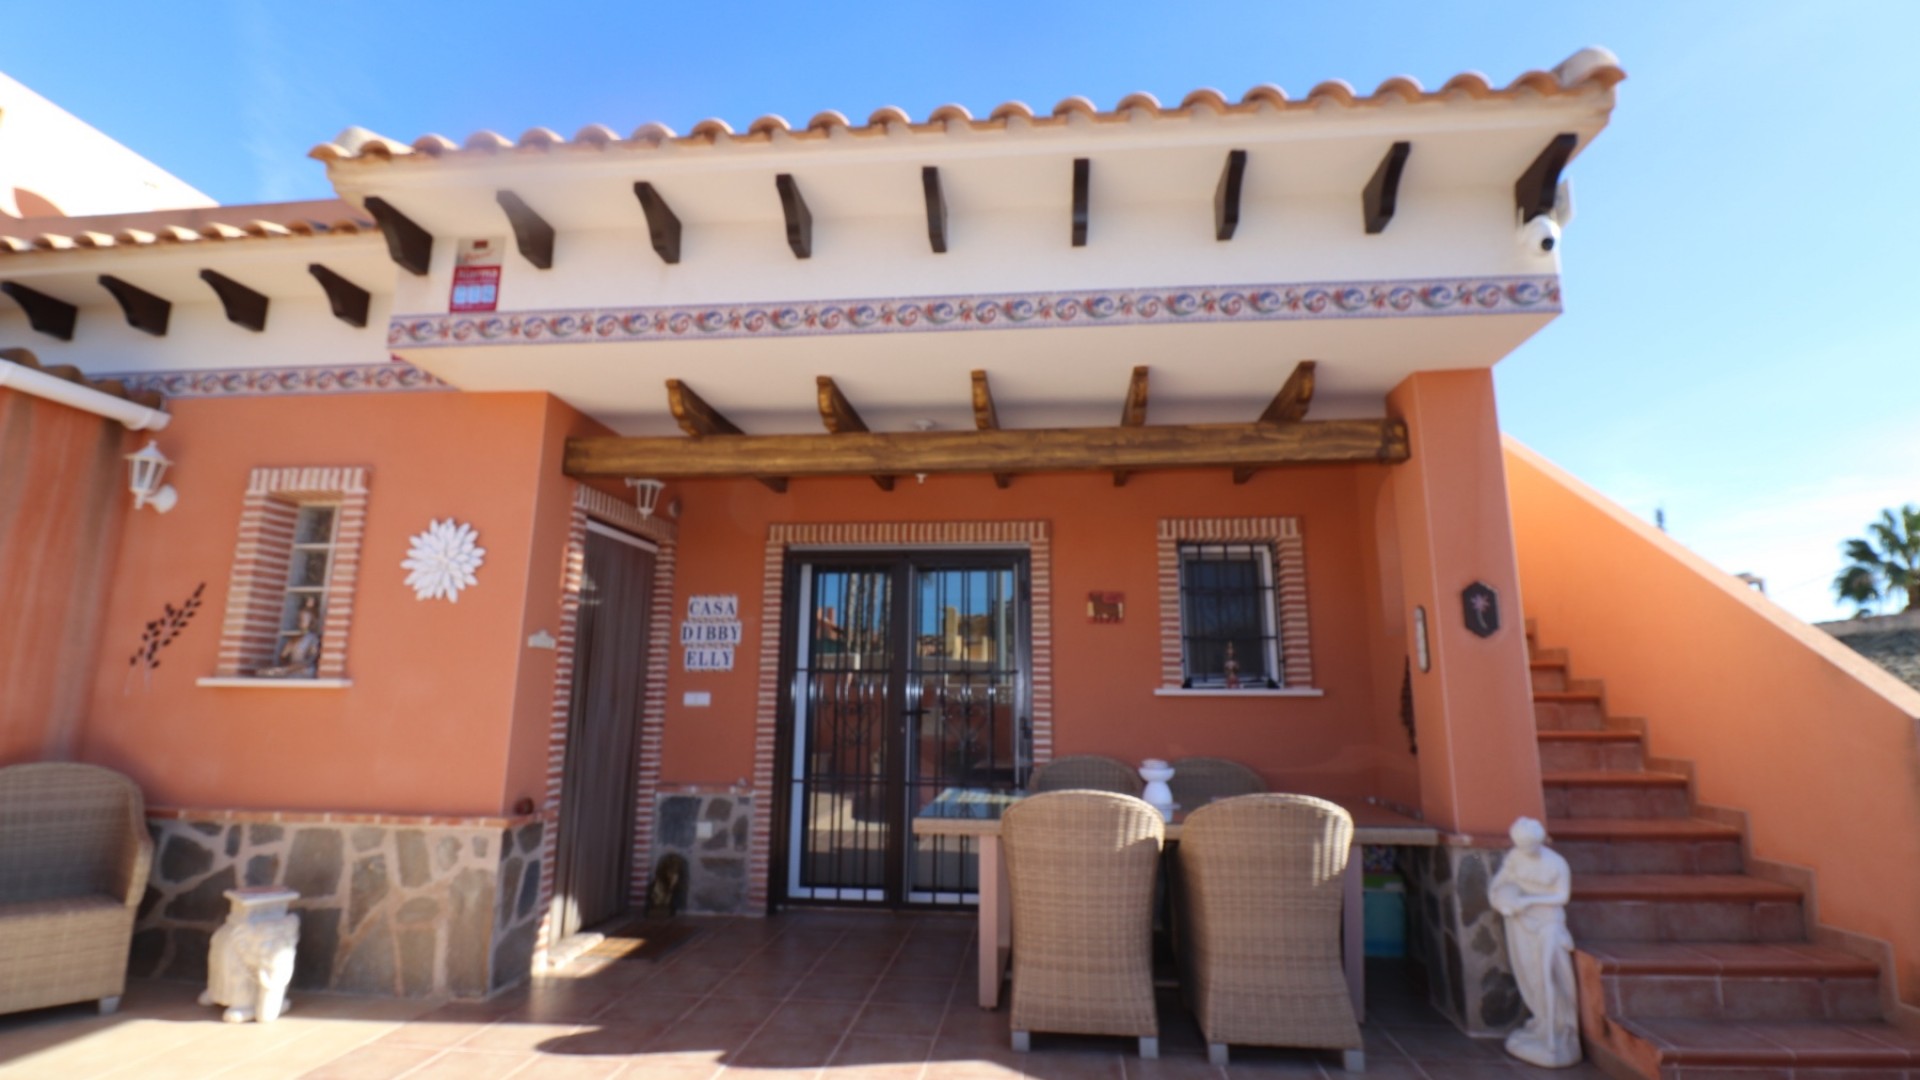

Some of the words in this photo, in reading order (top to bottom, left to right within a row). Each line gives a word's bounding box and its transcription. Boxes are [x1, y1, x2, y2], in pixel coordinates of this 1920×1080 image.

[689, 600, 735, 616] CASA
[682, 625, 739, 641] DIBBY
[686, 650, 731, 667] ELLY
